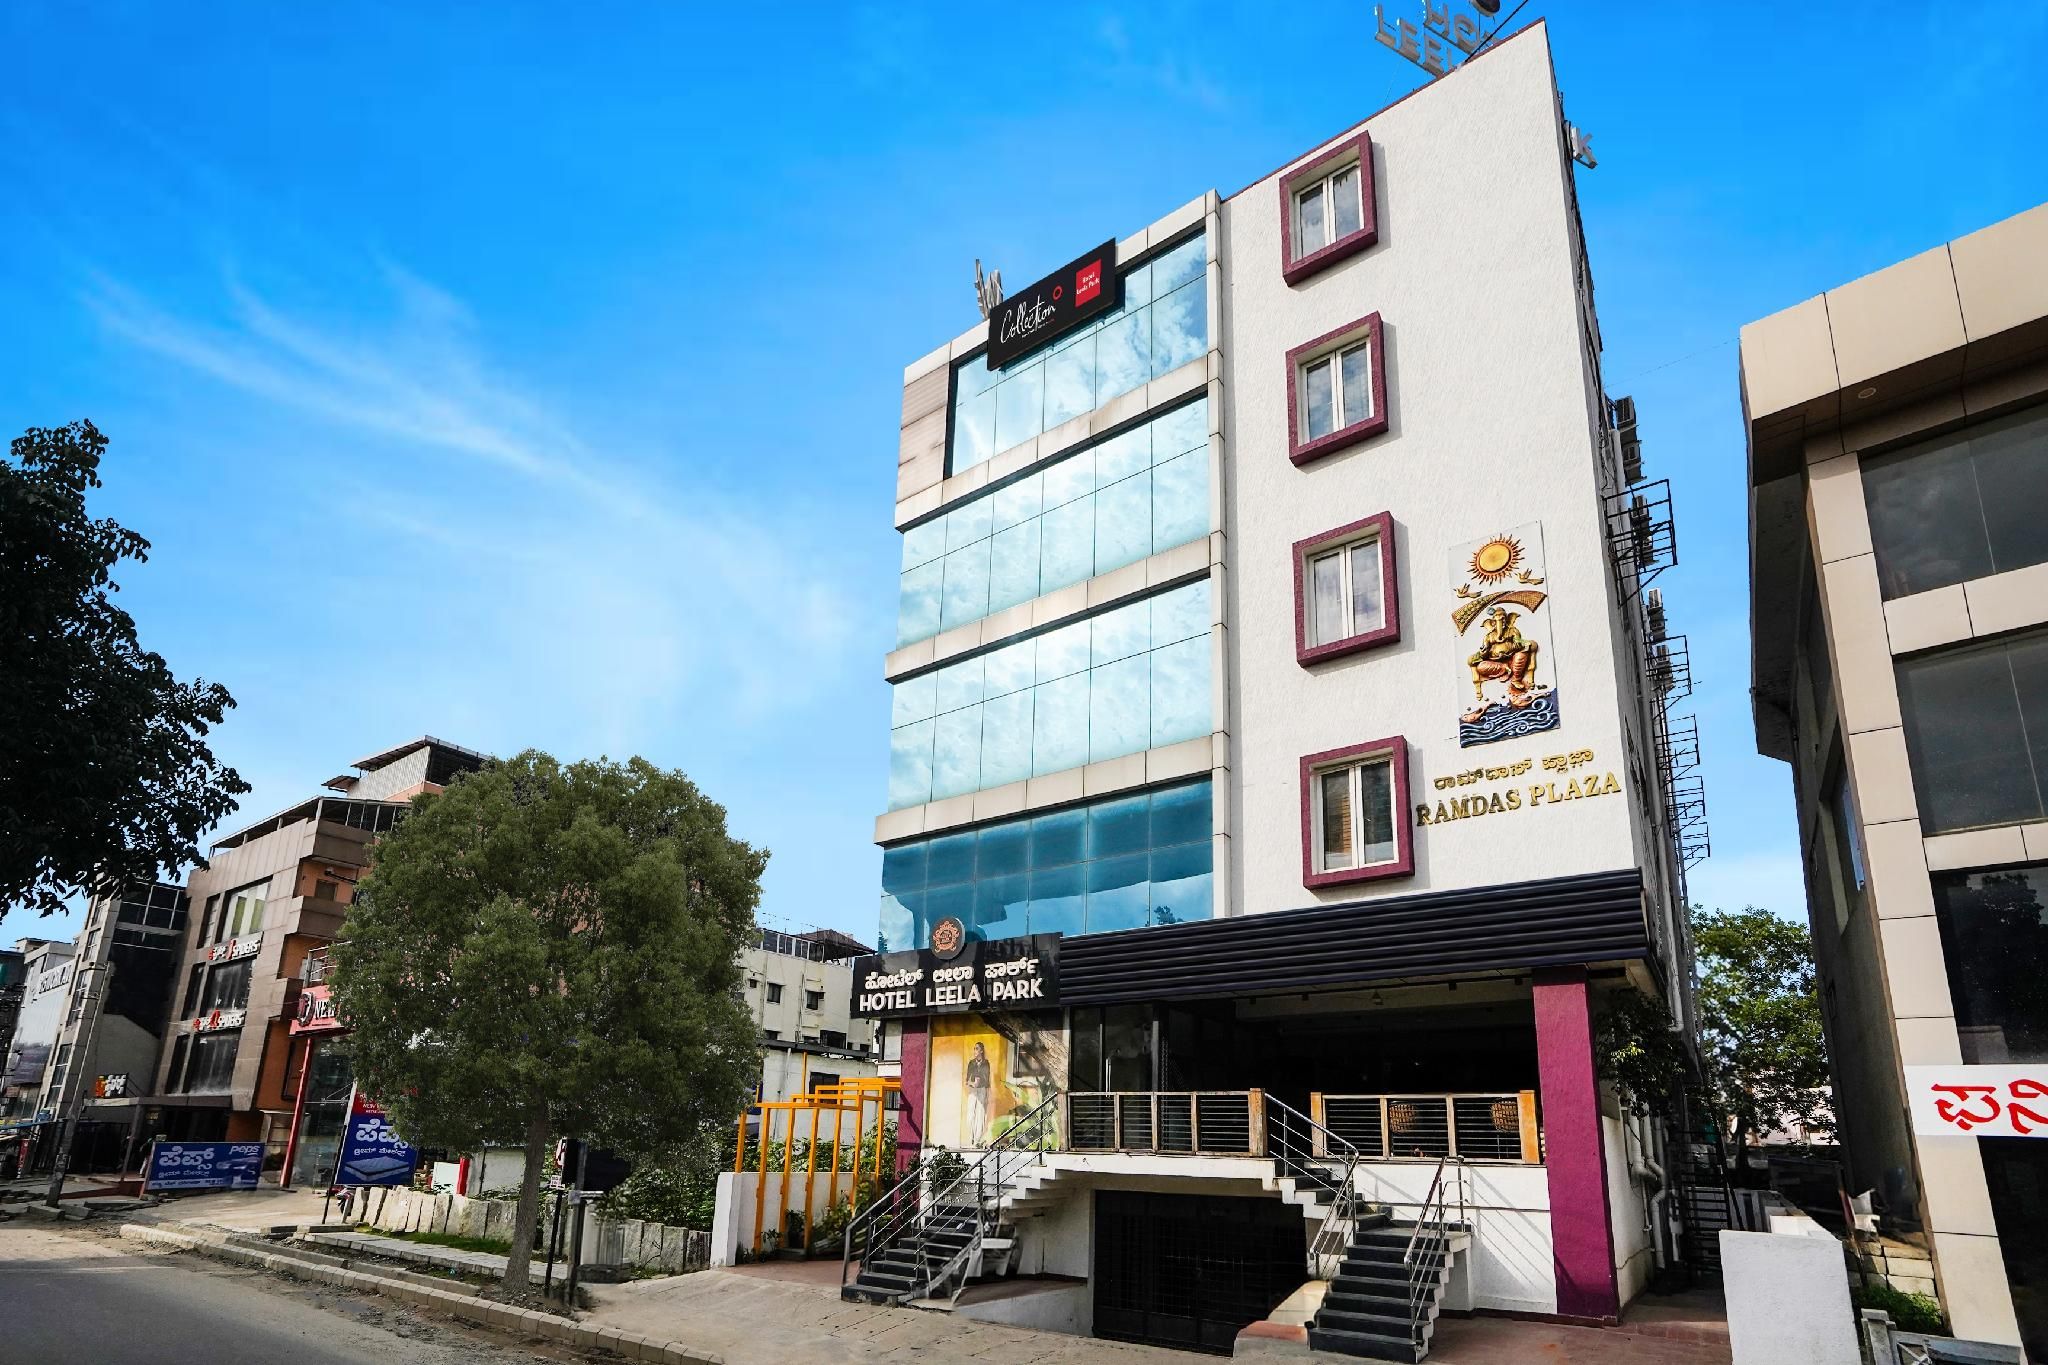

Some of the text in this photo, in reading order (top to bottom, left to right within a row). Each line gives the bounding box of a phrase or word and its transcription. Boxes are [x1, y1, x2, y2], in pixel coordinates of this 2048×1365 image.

[1000, 294, 1057, 344] Collection
[1415, 771, 1622, 827] RAMDAS PLAZA
[859, 977, 1044, 1012] HOTEL LEELA PARK
[865, 968, 924, 990] ಹೋಟೆಲ್
[932, 965, 974, 983] ಲೀಲಾ
